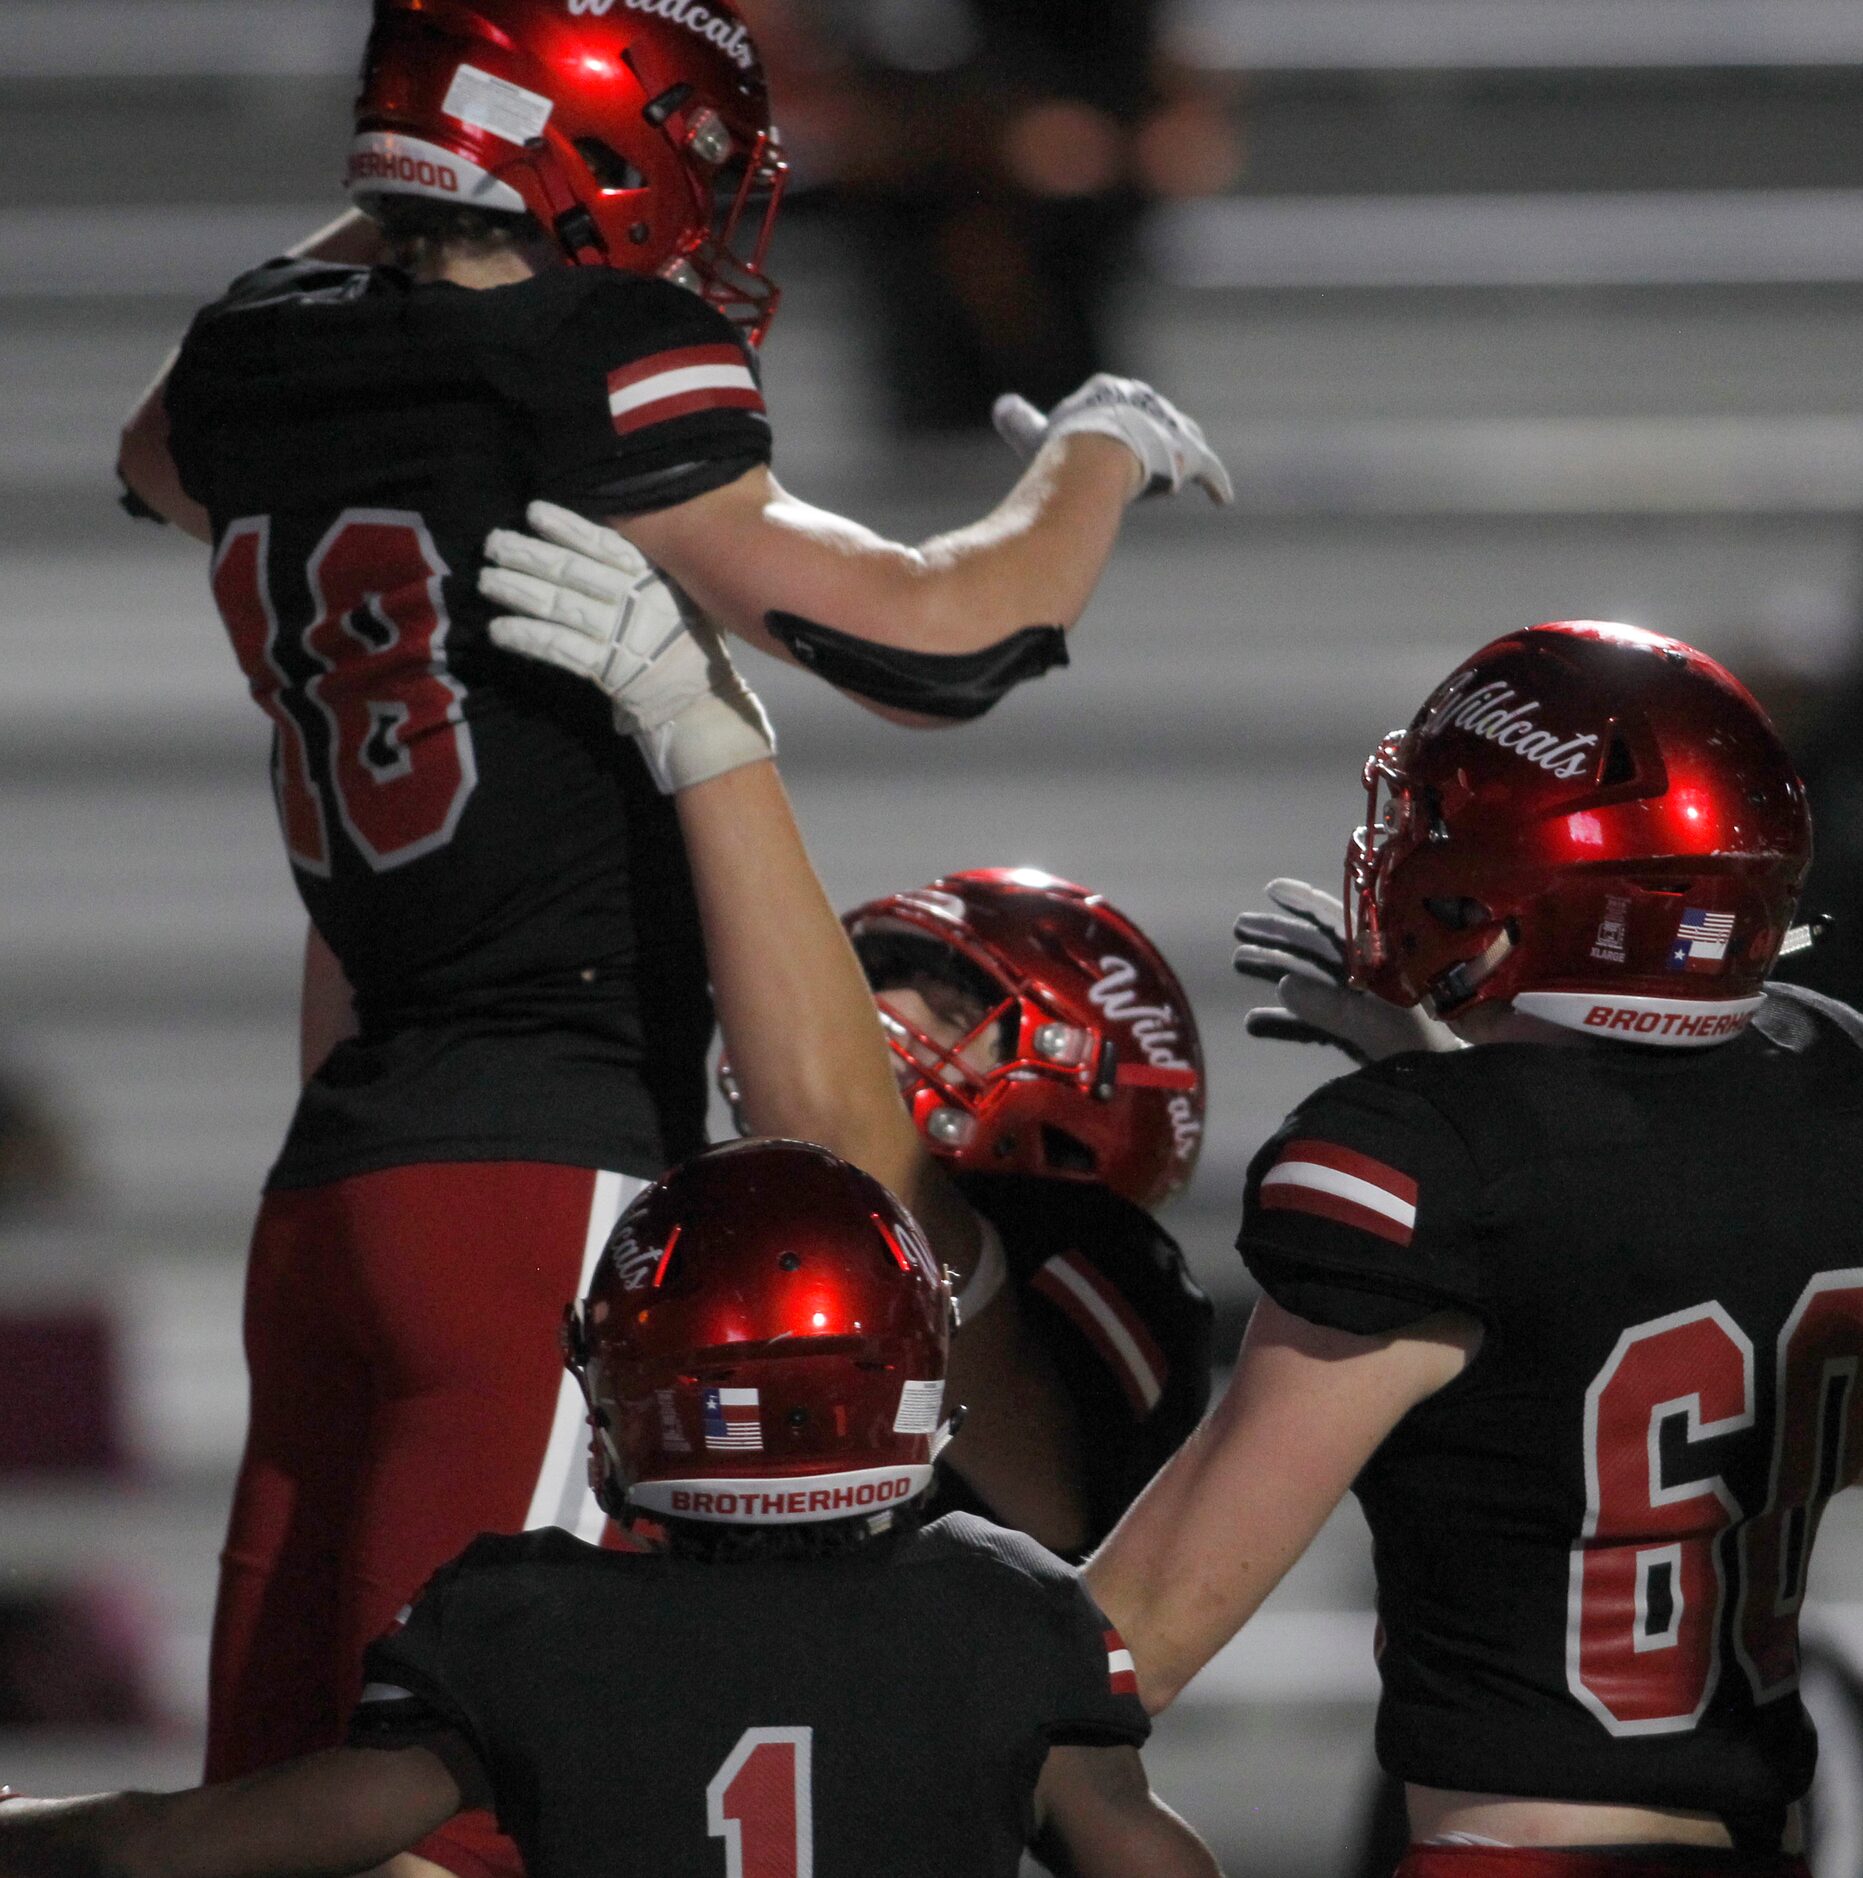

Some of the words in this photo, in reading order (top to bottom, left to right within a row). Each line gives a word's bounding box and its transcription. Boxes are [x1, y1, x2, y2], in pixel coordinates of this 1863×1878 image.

[210, 507, 480, 878] 18
[1088, 955, 1200, 1160] Wildats
[671, 1477, 911, 1515] BROTHERHOOD
[706, 1726, 813, 1878] 1
